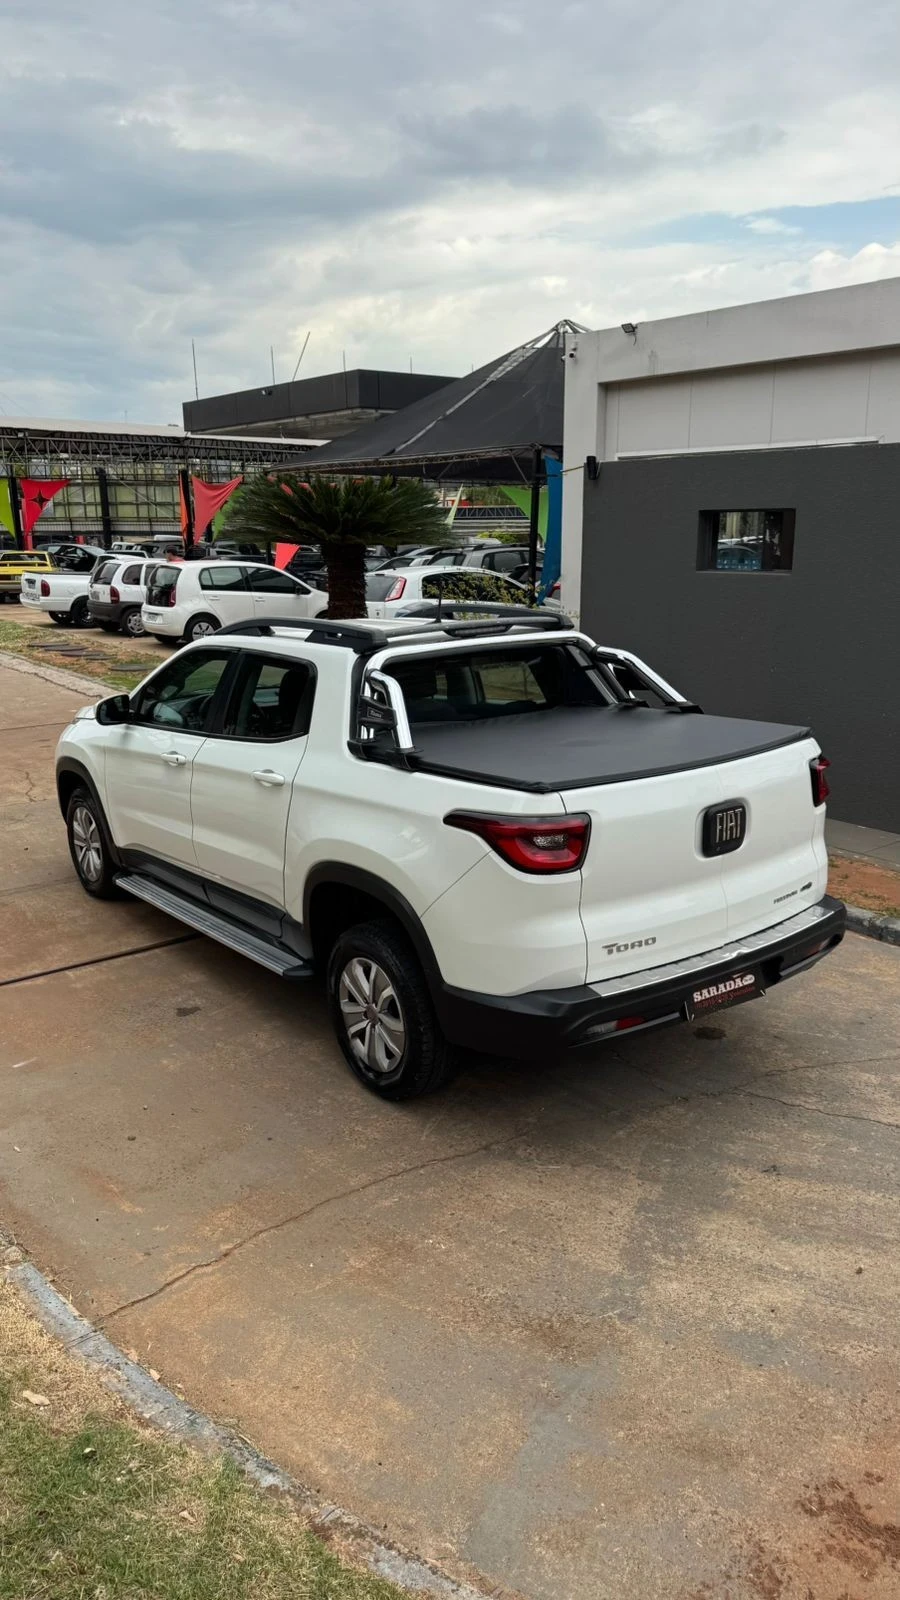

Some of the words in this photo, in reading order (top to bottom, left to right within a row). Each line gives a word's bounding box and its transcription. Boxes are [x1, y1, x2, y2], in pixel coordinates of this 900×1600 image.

[715, 807, 743, 843] FIAT
[601, 936, 657, 955] TORO
[692, 977, 744, 1003] SARADA
